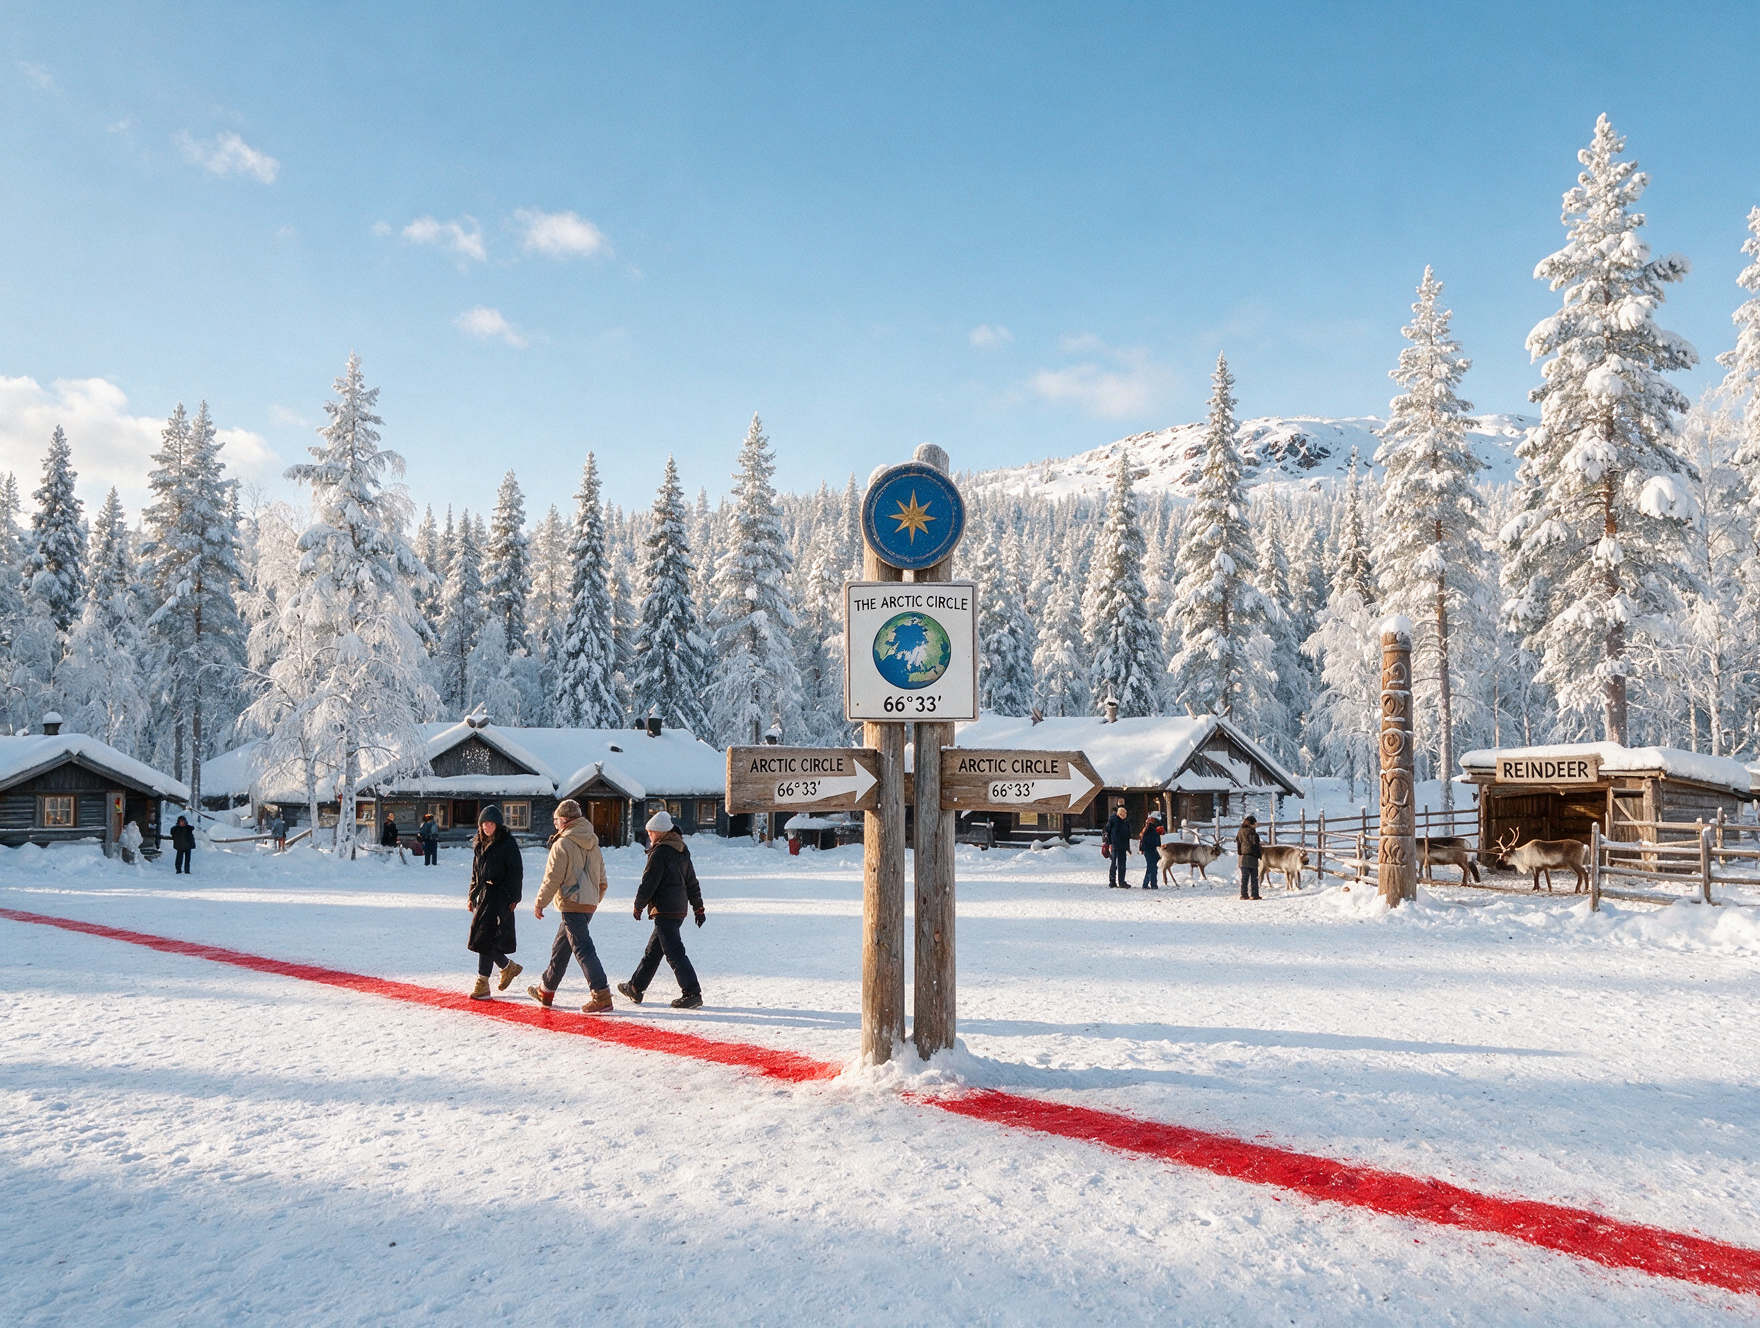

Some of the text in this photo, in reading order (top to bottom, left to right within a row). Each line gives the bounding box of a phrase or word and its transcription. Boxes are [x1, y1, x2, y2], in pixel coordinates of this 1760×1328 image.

[853, 595, 969, 612] THE ARCTIC CIRCLE
[750, 757, 844, 773] ARCTIC CIRCLE
[958, 758, 1059, 774] ARCTIC CIRCLE
[1503, 760, 1589, 779] REINDEER
